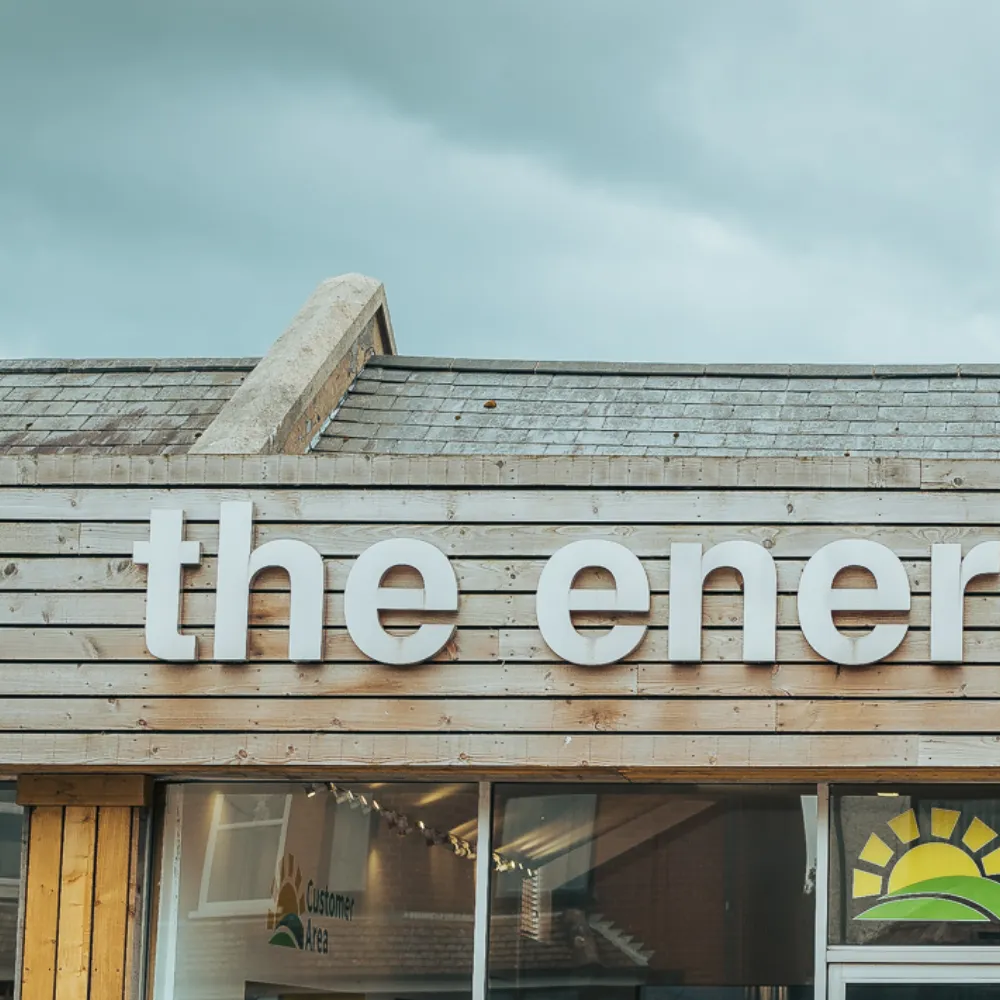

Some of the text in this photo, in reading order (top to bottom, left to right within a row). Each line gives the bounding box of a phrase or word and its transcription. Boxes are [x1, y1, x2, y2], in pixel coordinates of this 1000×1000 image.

[132, 501, 459, 665] the
[306, 879, 355, 921] Customer
[304, 918, 329, 954] Area
